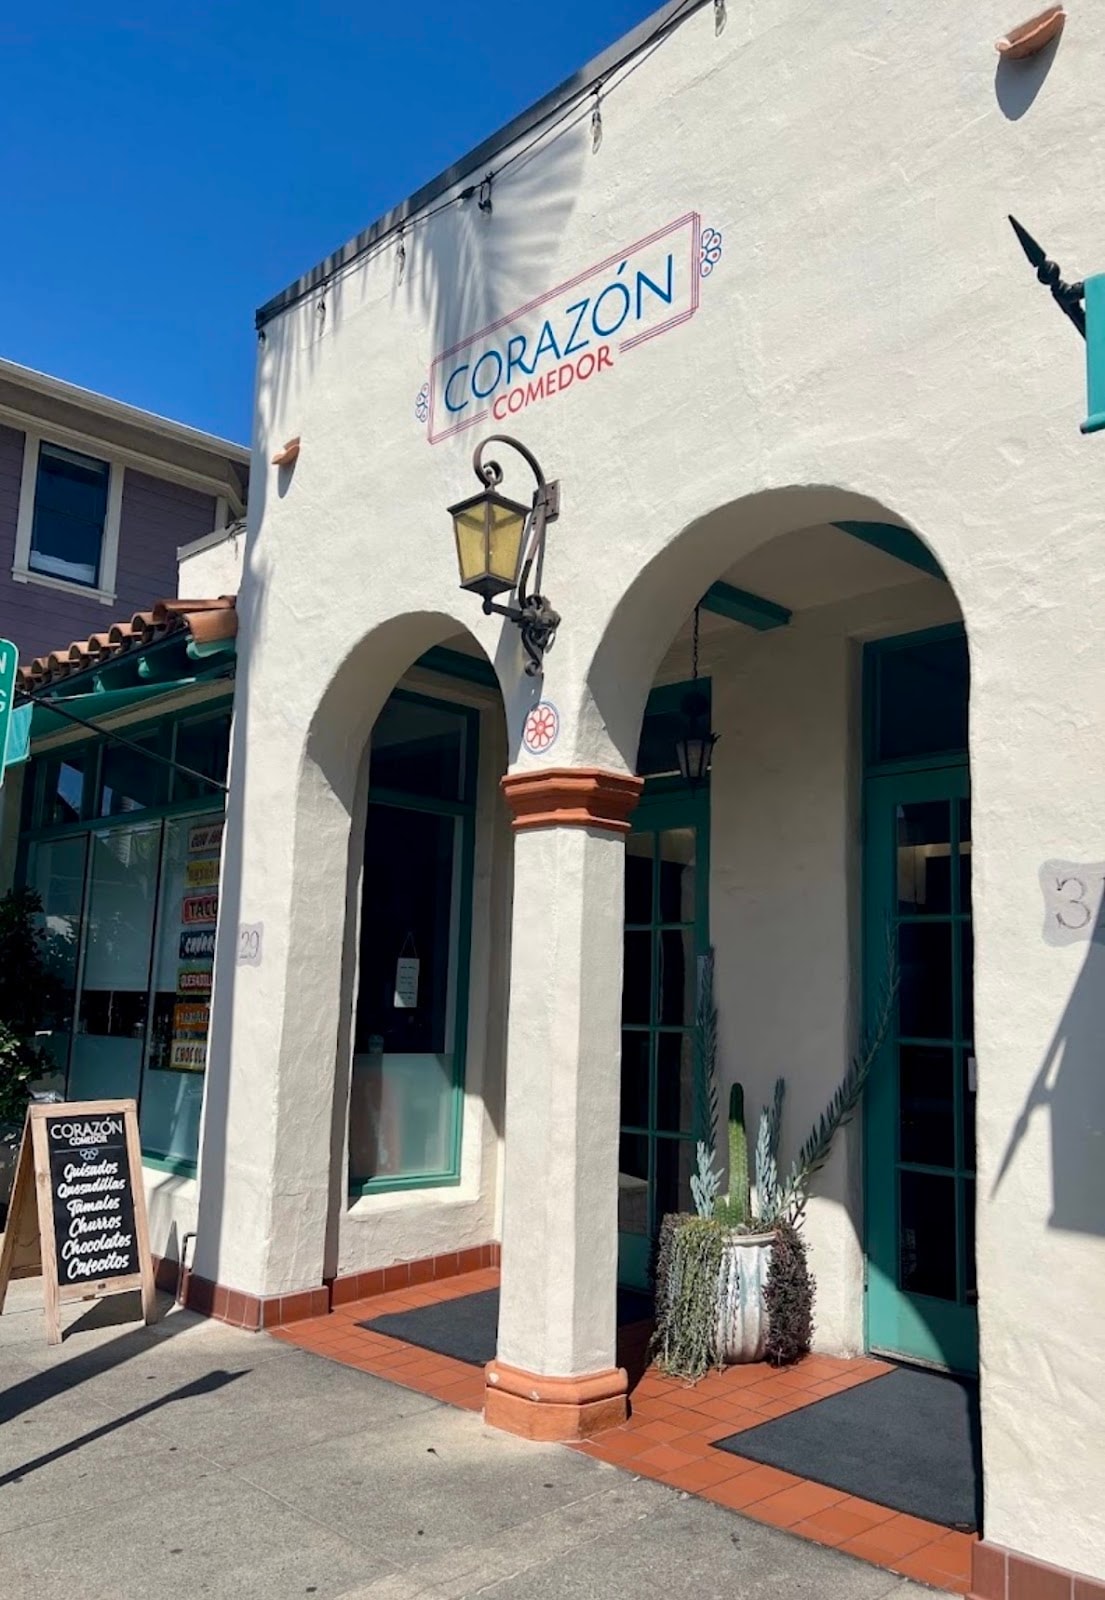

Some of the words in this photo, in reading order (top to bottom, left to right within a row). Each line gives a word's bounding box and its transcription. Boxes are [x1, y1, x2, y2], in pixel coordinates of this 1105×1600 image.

[444, 253, 673, 412] CORAZÓN
[492, 345, 614, 421] COMEDOR
[185, 933, 215, 954] CHURR
[239, 930, 260, 960] 29
[51, 1117, 123, 1139] CORAZÓN
[69, 1134, 108, 1146] COMEDOR
[64, 1159, 119, 1183] Guisados
[57, 1176, 126, 1199] Quesadillas
[66, 1194, 121, 1218] Tamales
[69, 1216, 122, 1238] Churros
[62, 1231, 132, 1260] Chocolates
[67, 1251, 130, 1279] Cafecitos
